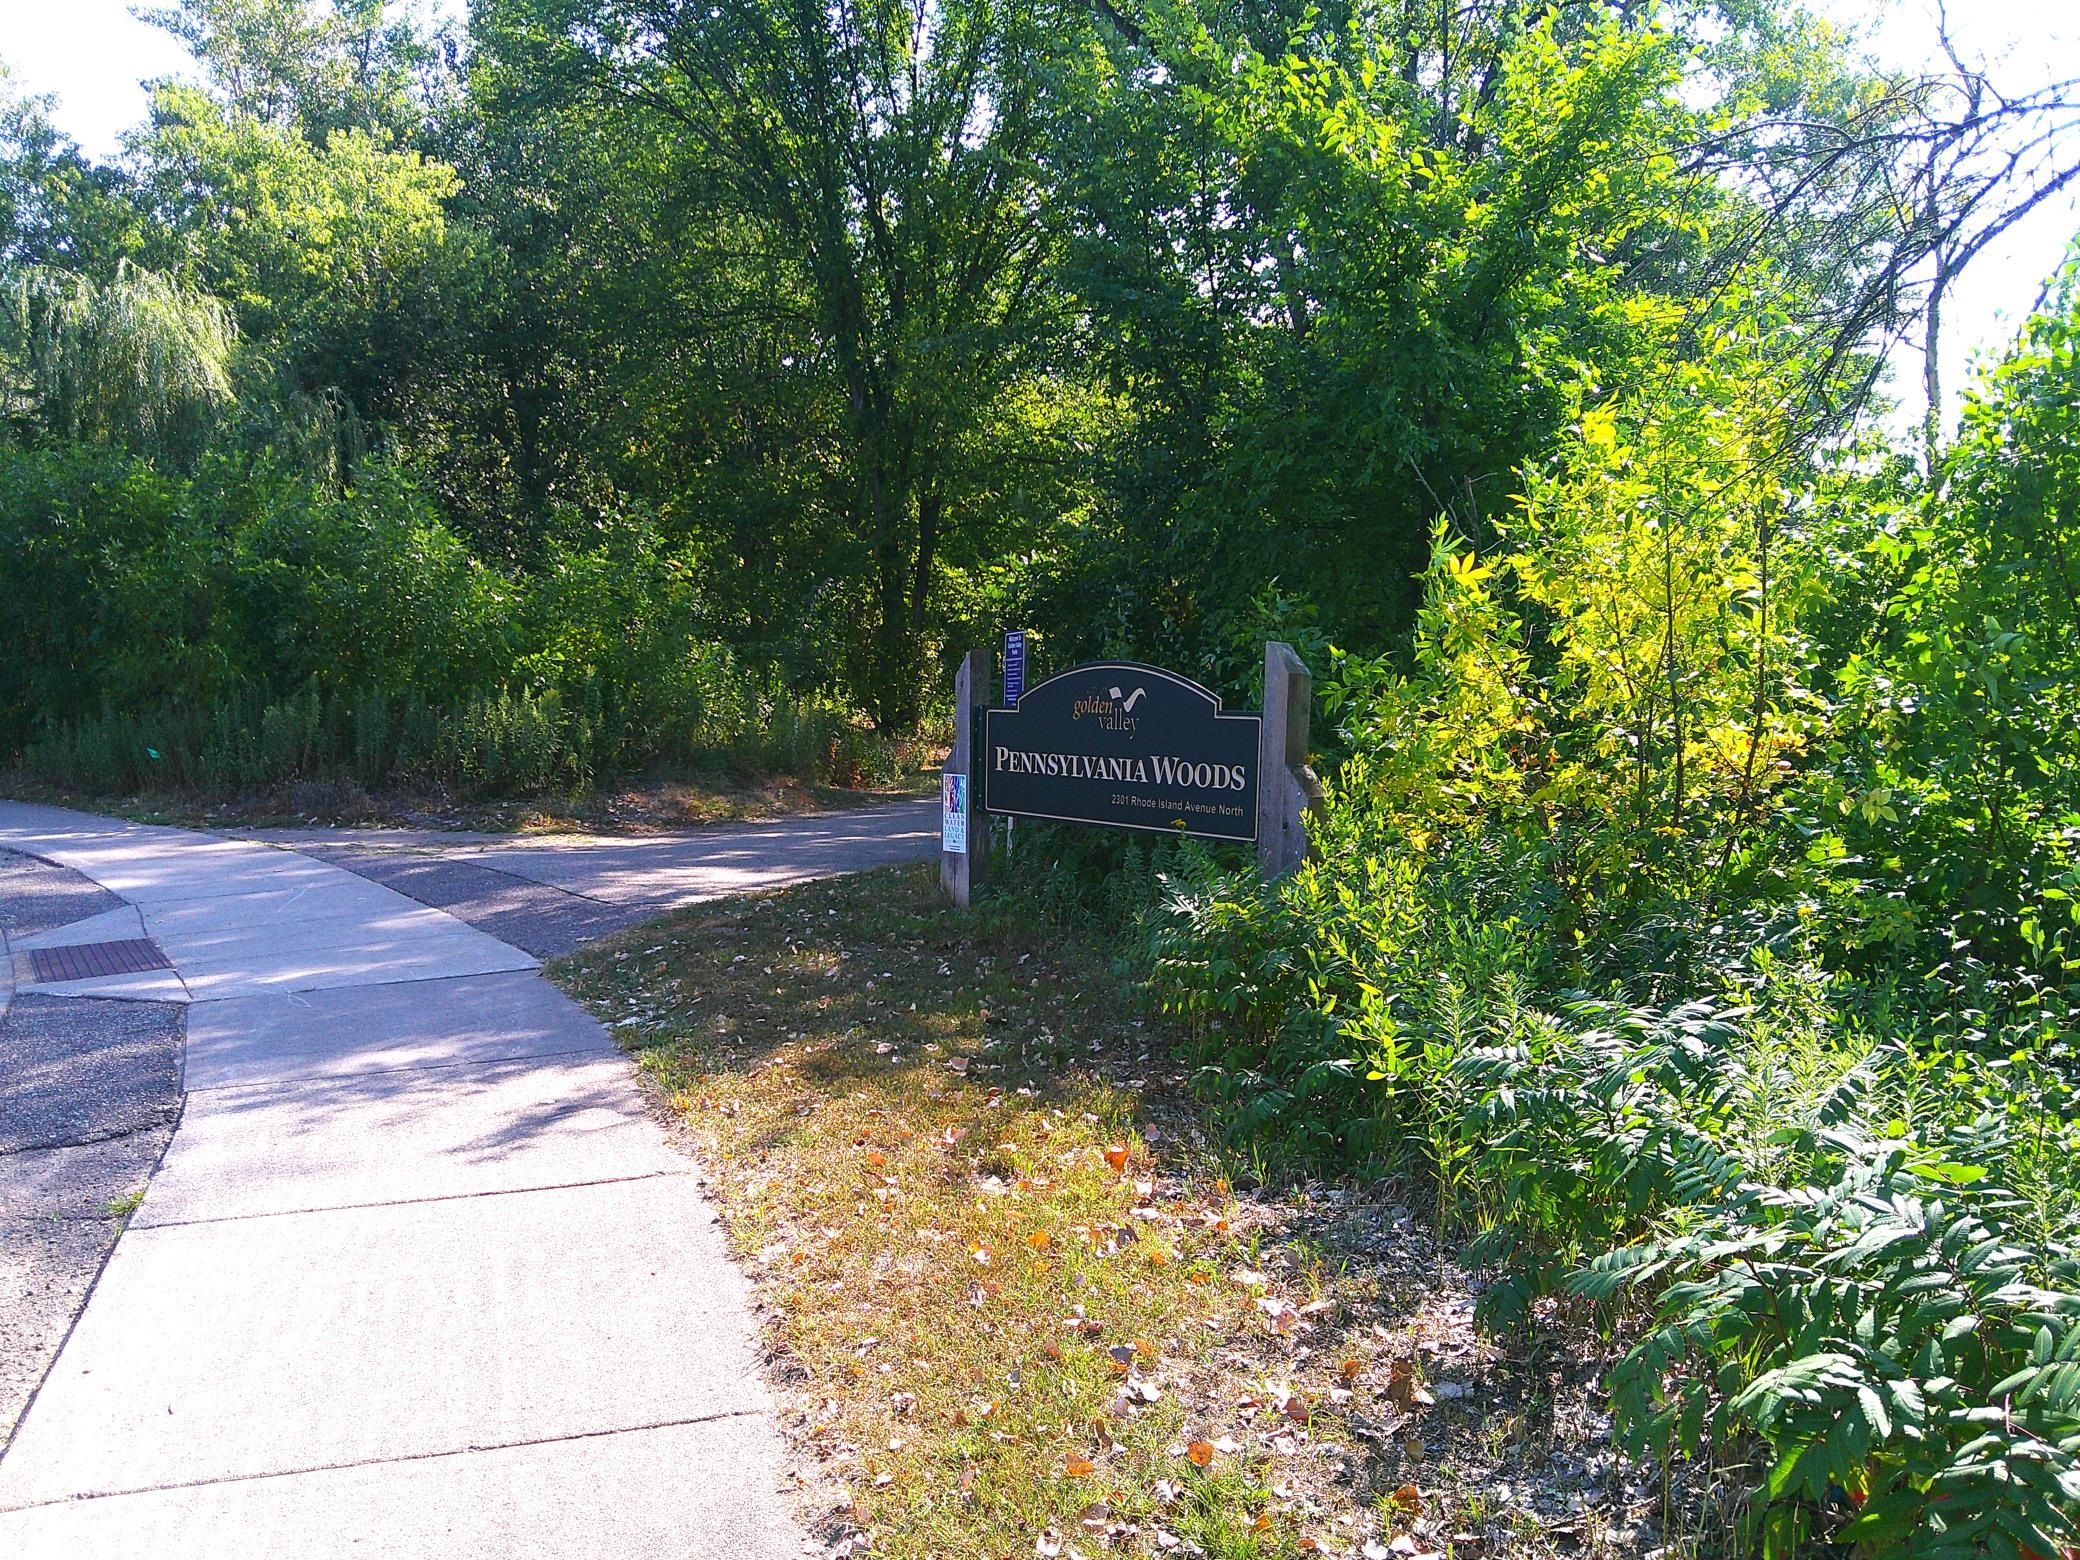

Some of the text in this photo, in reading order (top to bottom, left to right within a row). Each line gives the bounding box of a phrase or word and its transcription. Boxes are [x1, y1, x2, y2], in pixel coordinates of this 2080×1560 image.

[1072, 695, 1113, 720] golden
[1098, 708, 1140, 740] valley
[994, 746, 1246, 791] PENNSYLVANIA WOODS
[1111, 794, 1244, 817] 2301 Rhode Island Avenue North
[944, 812, 965, 820] CLEAN
[944, 819, 965, 827] WATER
[944, 825, 960, 833] LAND
[944, 832, 964, 840] LEGACY
